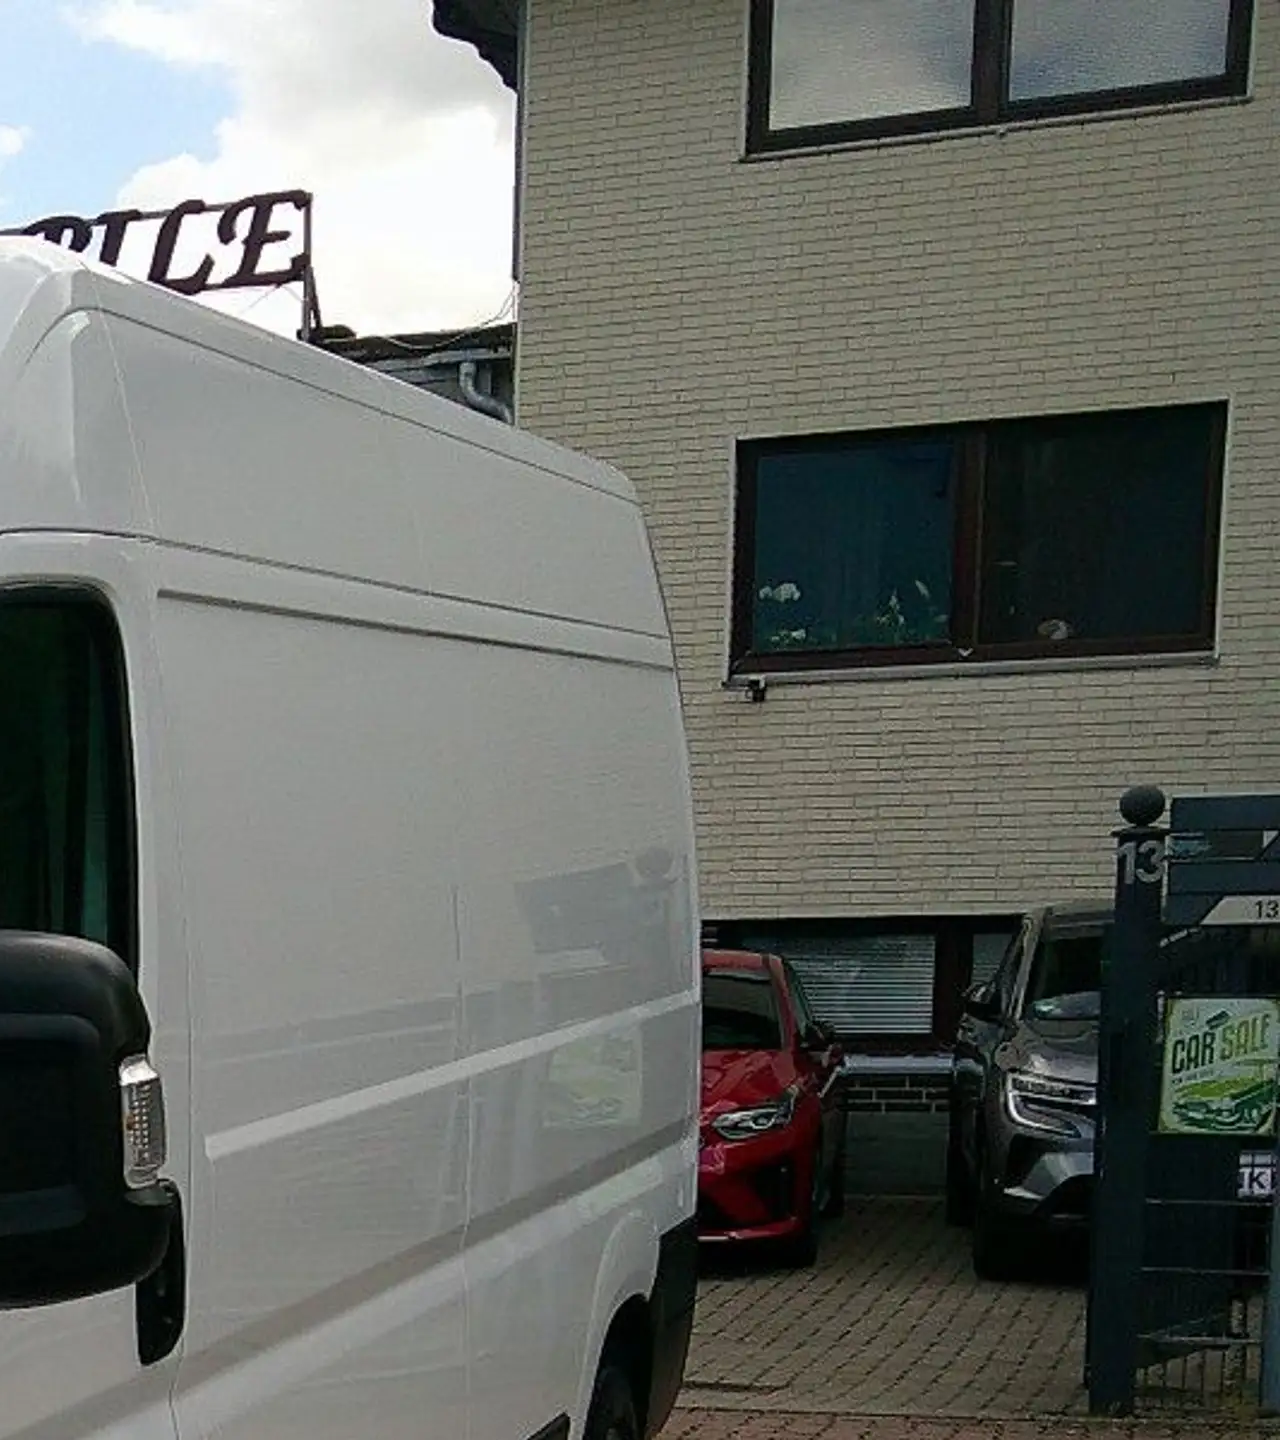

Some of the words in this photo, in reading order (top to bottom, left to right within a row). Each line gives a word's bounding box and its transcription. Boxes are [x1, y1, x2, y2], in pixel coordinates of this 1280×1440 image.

[1118, 840, 1166, 884] 13
[1255, 900, 1279, 918] 13
[1172, 1031, 1216, 1074] CAR
[1220, 1013, 1271, 1060] SALE
